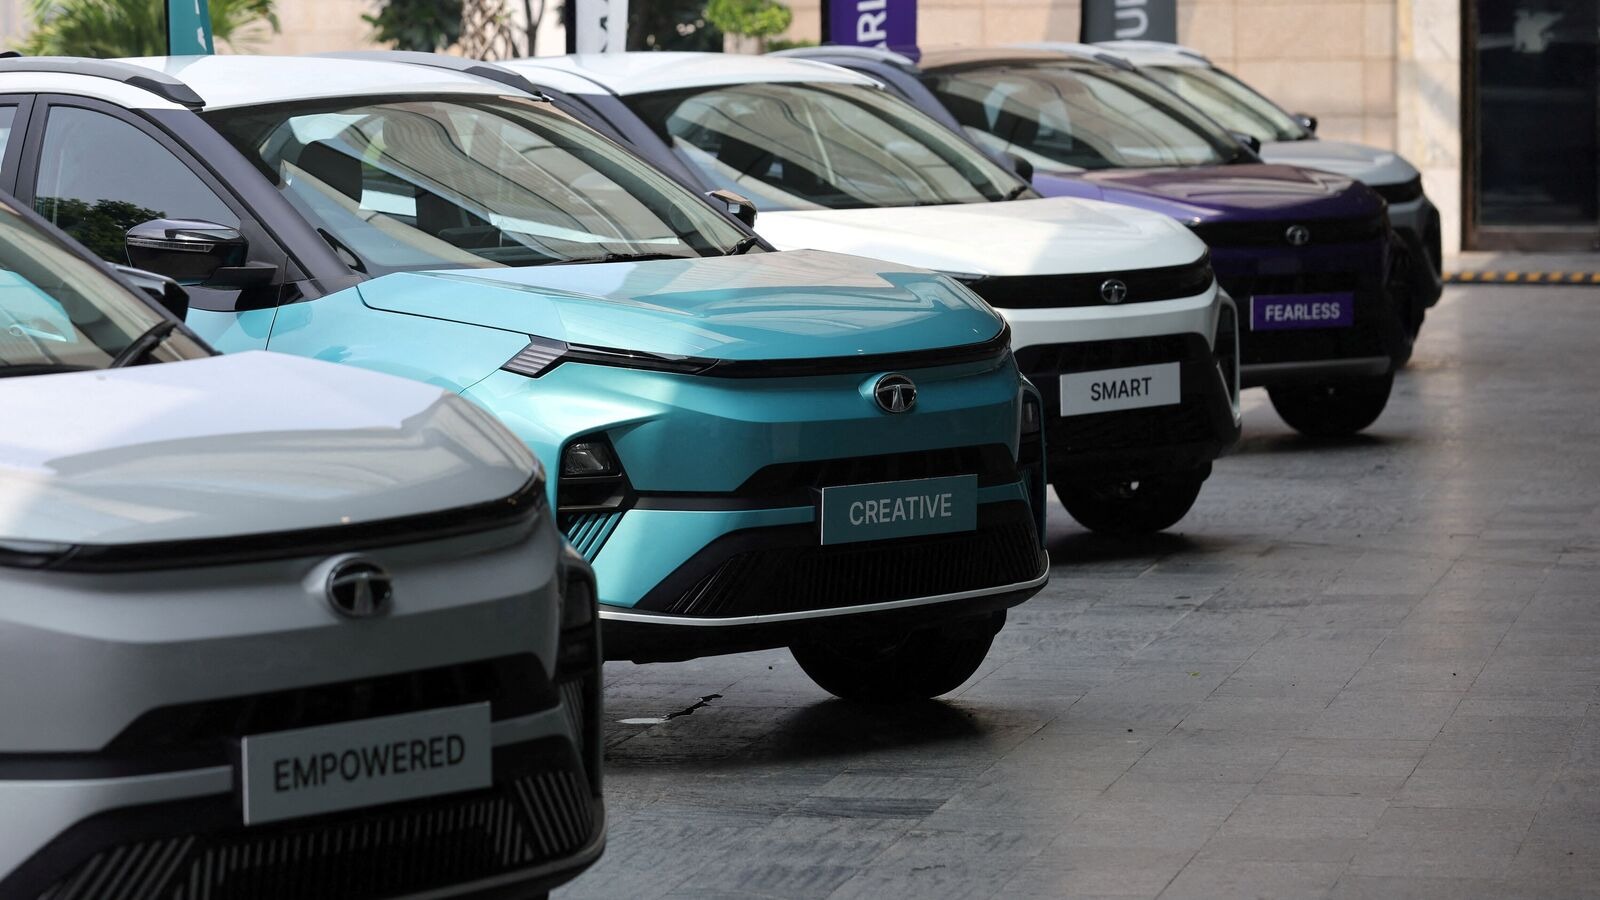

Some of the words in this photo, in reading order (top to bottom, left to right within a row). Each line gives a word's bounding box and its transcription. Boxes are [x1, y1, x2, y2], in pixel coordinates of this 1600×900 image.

[1265, 302, 1341, 322] FEARLESS
[1090, 376, 1152, 401] SMART
[849, 493, 952, 526] CREATIVE
[273, 734, 465, 793] EMPOWERED
